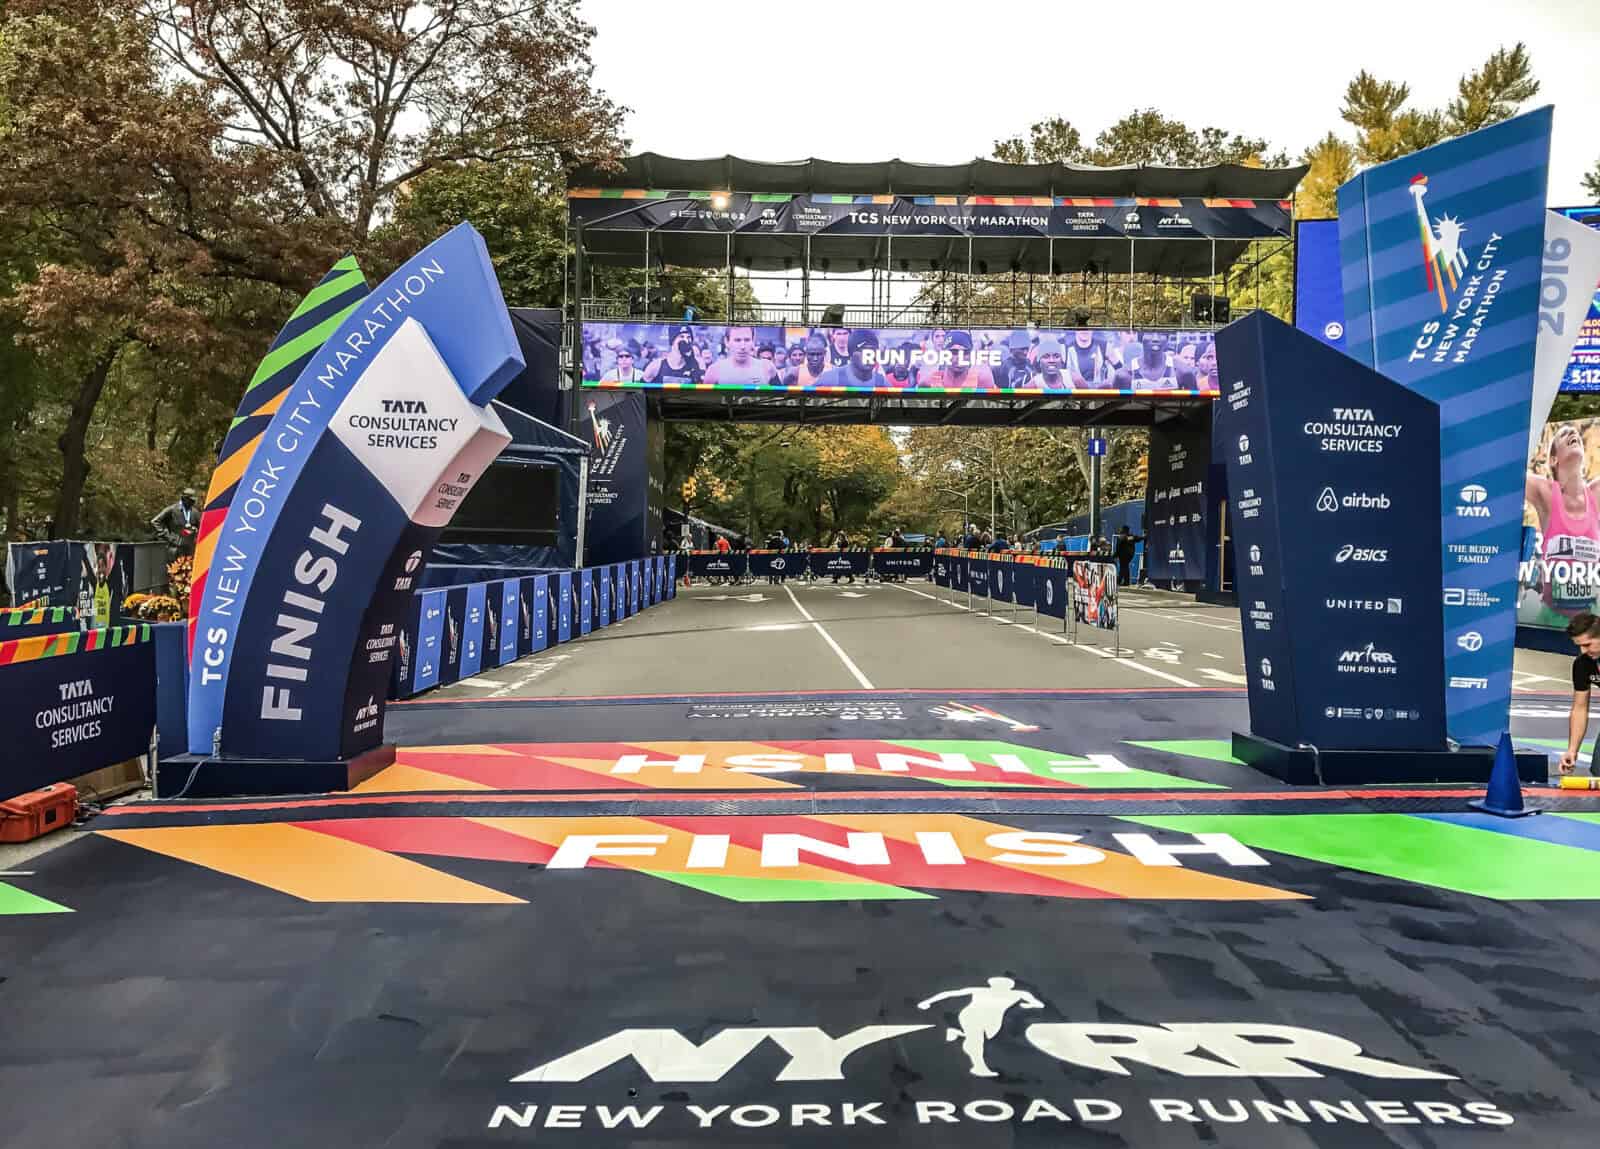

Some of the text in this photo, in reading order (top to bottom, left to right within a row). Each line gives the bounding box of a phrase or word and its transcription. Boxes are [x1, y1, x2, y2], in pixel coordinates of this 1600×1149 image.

[849, 212, 1049, 226] TCS NEW YORK CITY MARATHON
[1431, 231, 1503, 362] NEW YORK CITY
[1538, 237, 1572, 337] 2016
[1452, 269, 1508, 363] MARATHON
[1408, 321, 1440, 362] TCS
[862, 349, 1002, 367] RUN FOR LIFE
[382, 399, 428, 415] TATA
[1332, 408, 1375, 421] TATA
[349, 415, 459, 432] CONSULTANCY
[1303, 422, 1402, 438] CONSULTANCY
[367, 433, 438, 450] SERVICES
[1321, 438, 1383, 453] SERVICES
[201, 258, 446, 686] TCS NEW YORK CITY MARATHON
[1342, 492, 1391, 509] airbnb
[1456, 506, 1490, 518] TATA
[1457, 555, 1490, 564] FAMILY
[1538, 559, 1600, 586] YORK
[260, 503, 362, 721] FINISH
[1326, 599, 1384, 610] UNITED
[1337, 664, 1356, 673] RUN
[1377, 666, 1397, 674] LIFE
[59, 679, 93, 700] TATA
[35, 695, 114, 729] CONSULTANCY
[51, 720, 101, 748] SERVICES
[609, 753, 1134, 774] FINISH
[545, 831, 1270, 868] FINISH
[488, 1099, 1516, 1128] NEW YORK ROAD RUNNERS
